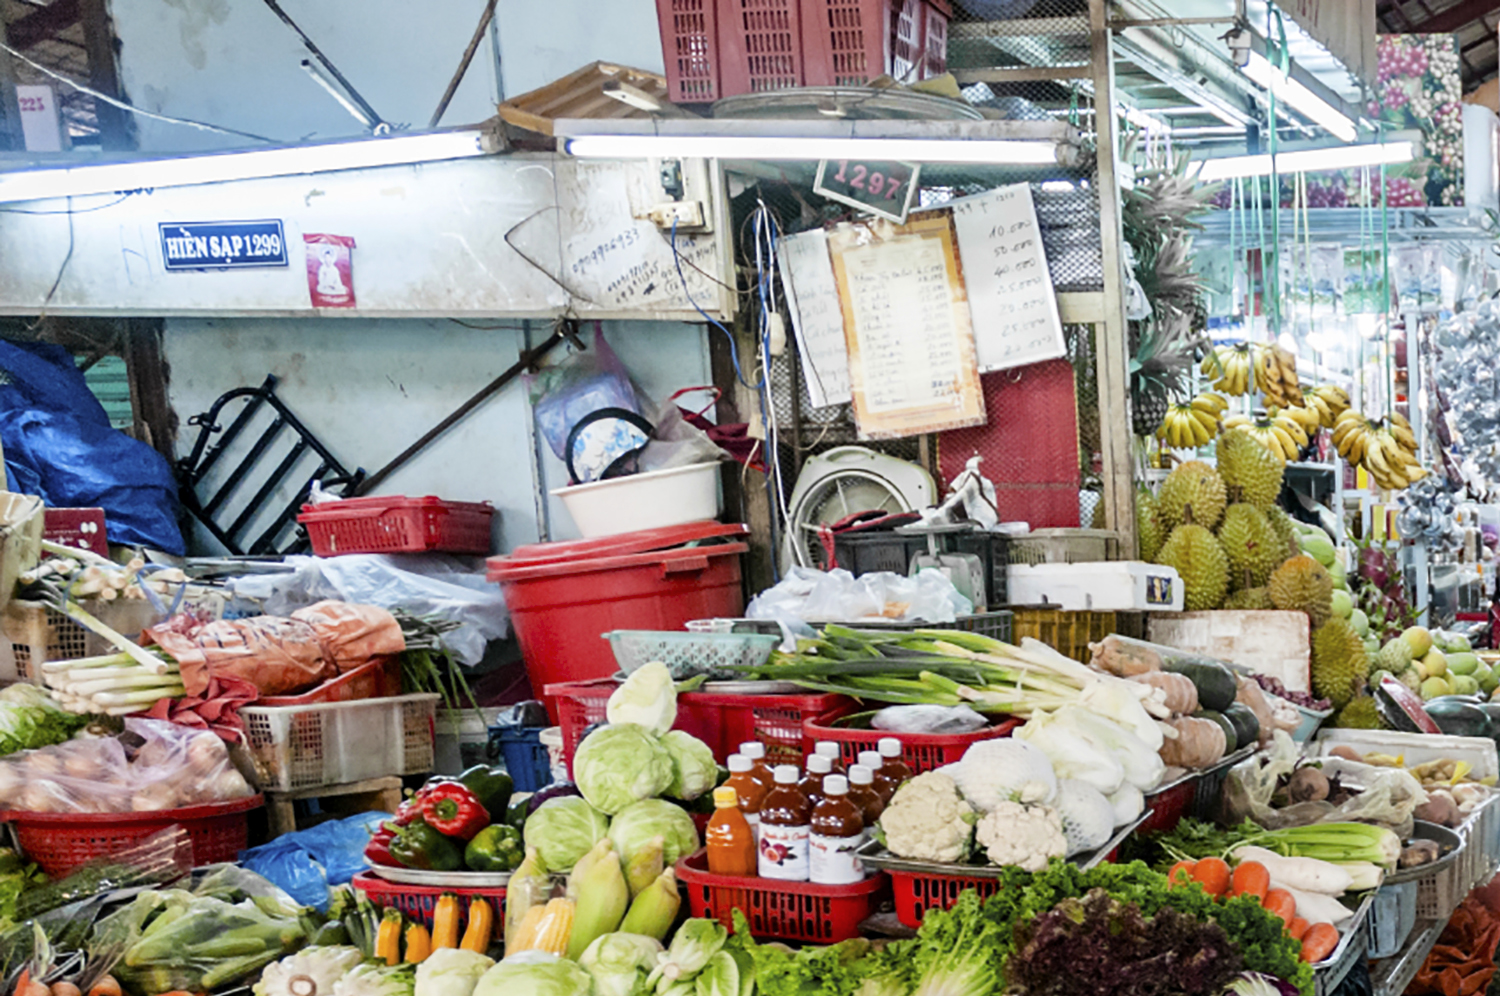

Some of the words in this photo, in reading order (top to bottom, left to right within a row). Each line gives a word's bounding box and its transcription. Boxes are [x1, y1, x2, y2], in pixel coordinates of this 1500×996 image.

[834, 160, 900, 200] 1297
[211, 234, 244, 263] SẠP
[246, 232, 281, 257] 1299
